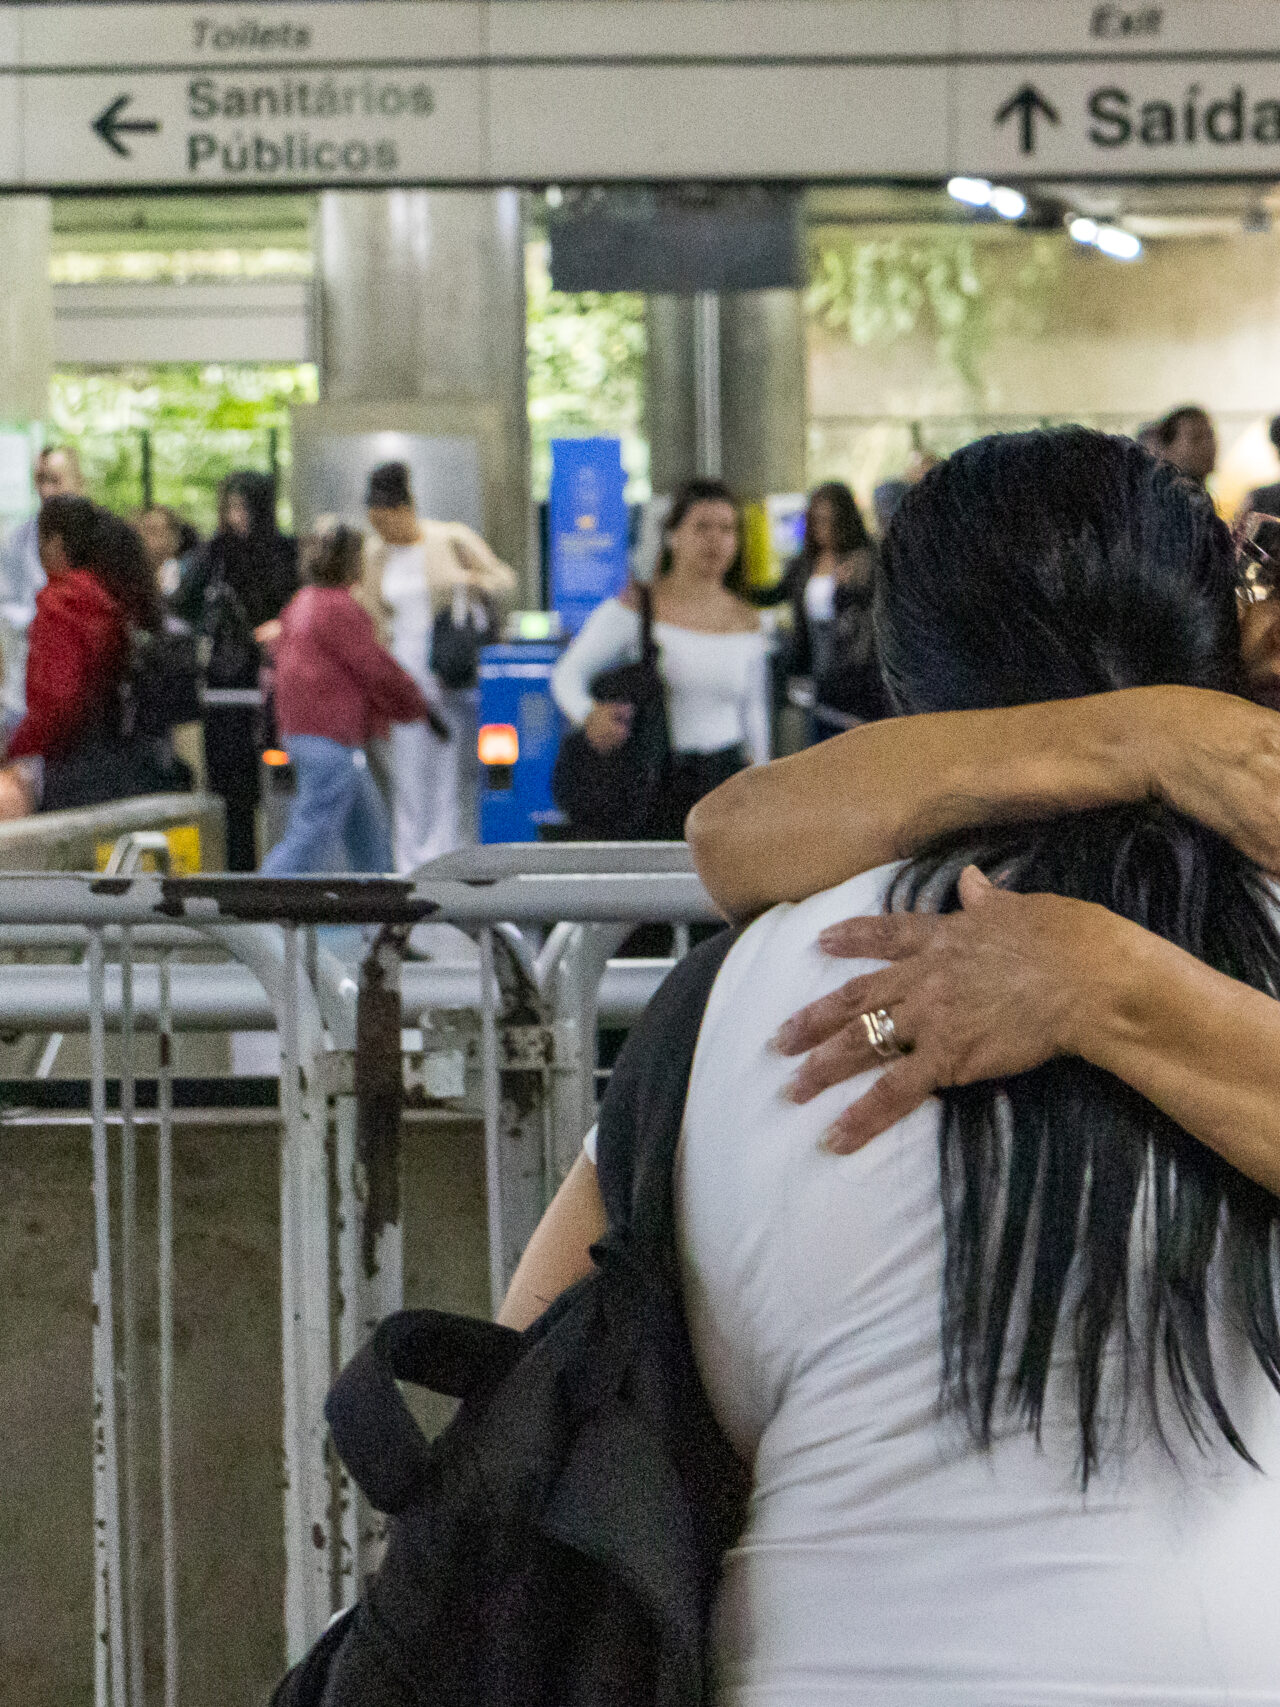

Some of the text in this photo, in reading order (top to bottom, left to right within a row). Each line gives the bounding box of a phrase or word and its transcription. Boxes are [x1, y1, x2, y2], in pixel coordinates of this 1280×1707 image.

[1090, 4, 1163, 39] Exit
[187, 74, 435, 121] Sanitários
[187, 127, 397, 173] Públicos
